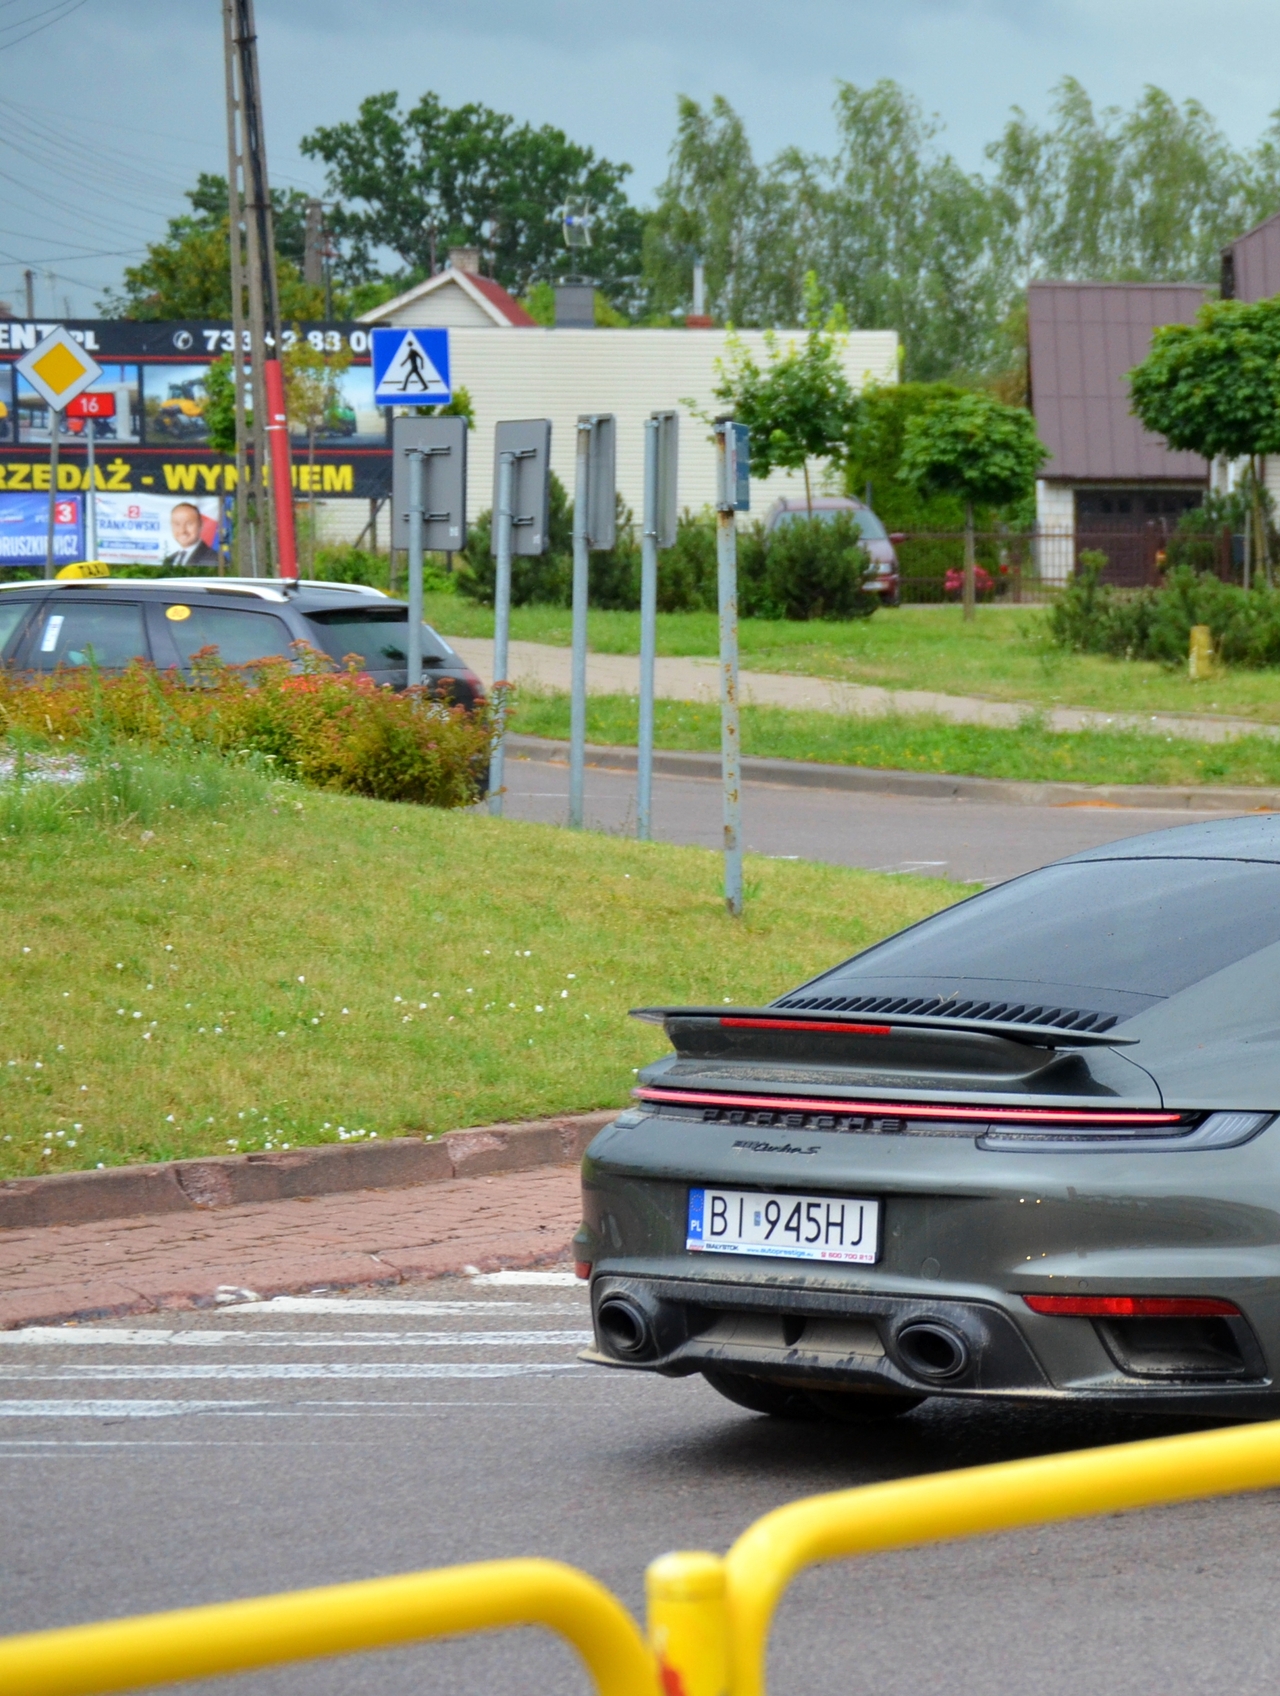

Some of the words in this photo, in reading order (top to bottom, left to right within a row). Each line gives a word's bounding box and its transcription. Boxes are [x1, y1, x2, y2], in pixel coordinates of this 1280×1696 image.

[307, 330, 341, 352] 83
[350, 331, 373, 352] 0
[81, 397, 99, 413] 16
[0, 457, 132, 491] ZEDAŻ
[59, 504, 72, 522] 3
[690, 1219, 703, 1232] PL
[710, 1195, 743, 1238] BI
[763, 1200, 864, 1246] 945HJ
